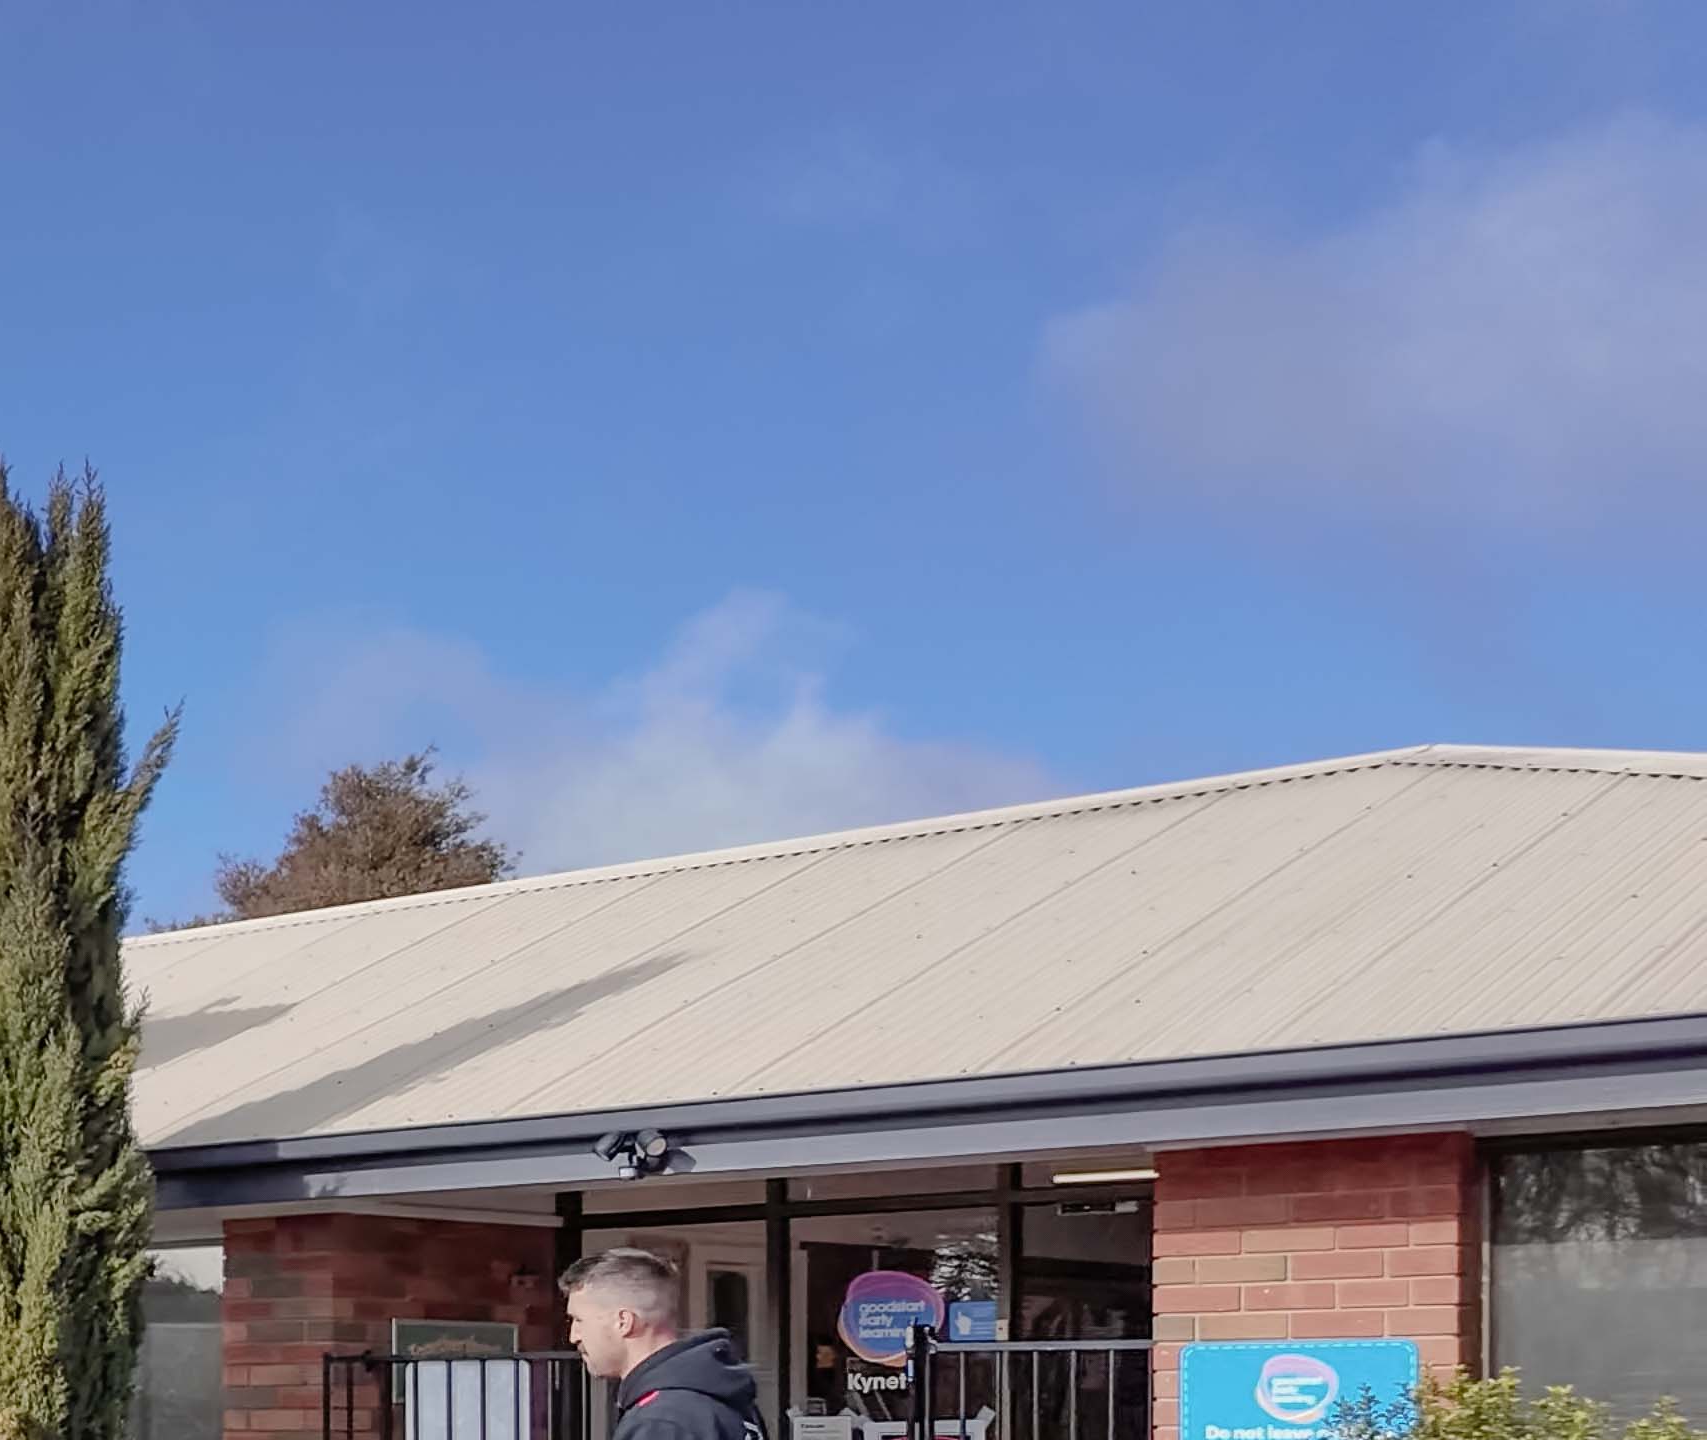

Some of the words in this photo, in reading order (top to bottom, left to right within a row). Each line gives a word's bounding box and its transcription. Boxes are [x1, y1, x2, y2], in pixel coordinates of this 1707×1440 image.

[859, 1301, 925, 1317] goodstart
[847, 1373, 907, 1393] Kynet
[1205, 1425, 1230, 1440] Do
[1233, 1427, 1264, 1440] not
